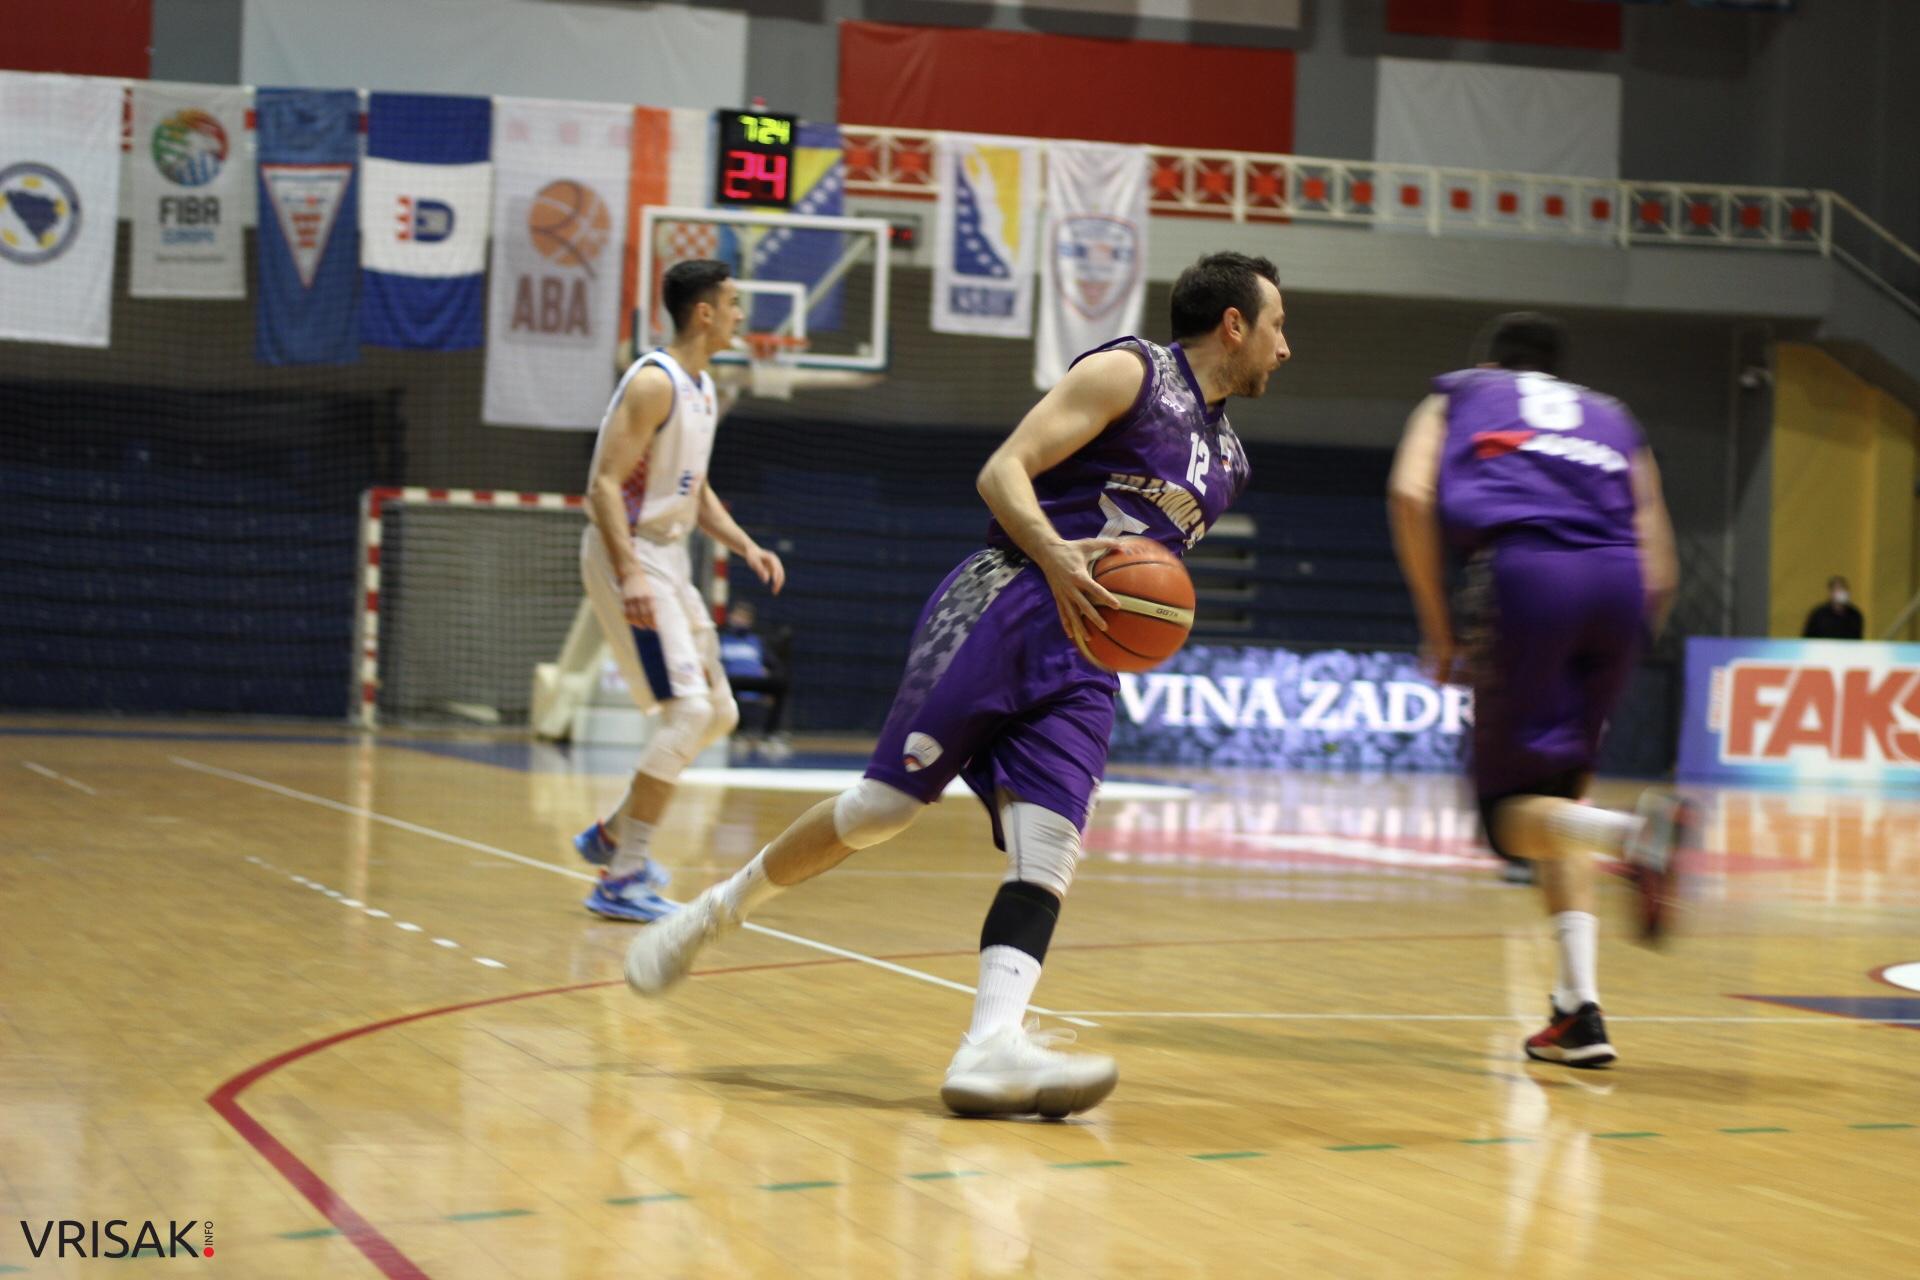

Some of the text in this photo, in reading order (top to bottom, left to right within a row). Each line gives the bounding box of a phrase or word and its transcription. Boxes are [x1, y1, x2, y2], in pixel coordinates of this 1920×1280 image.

[723, 151, 788, 199] 24
[159, 195, 220, 225] FIBA
[512, 274, 592, 336] ABA
[1186, 432, 1210, 496] 12
[1118, 673, 1286, 729] VINA
